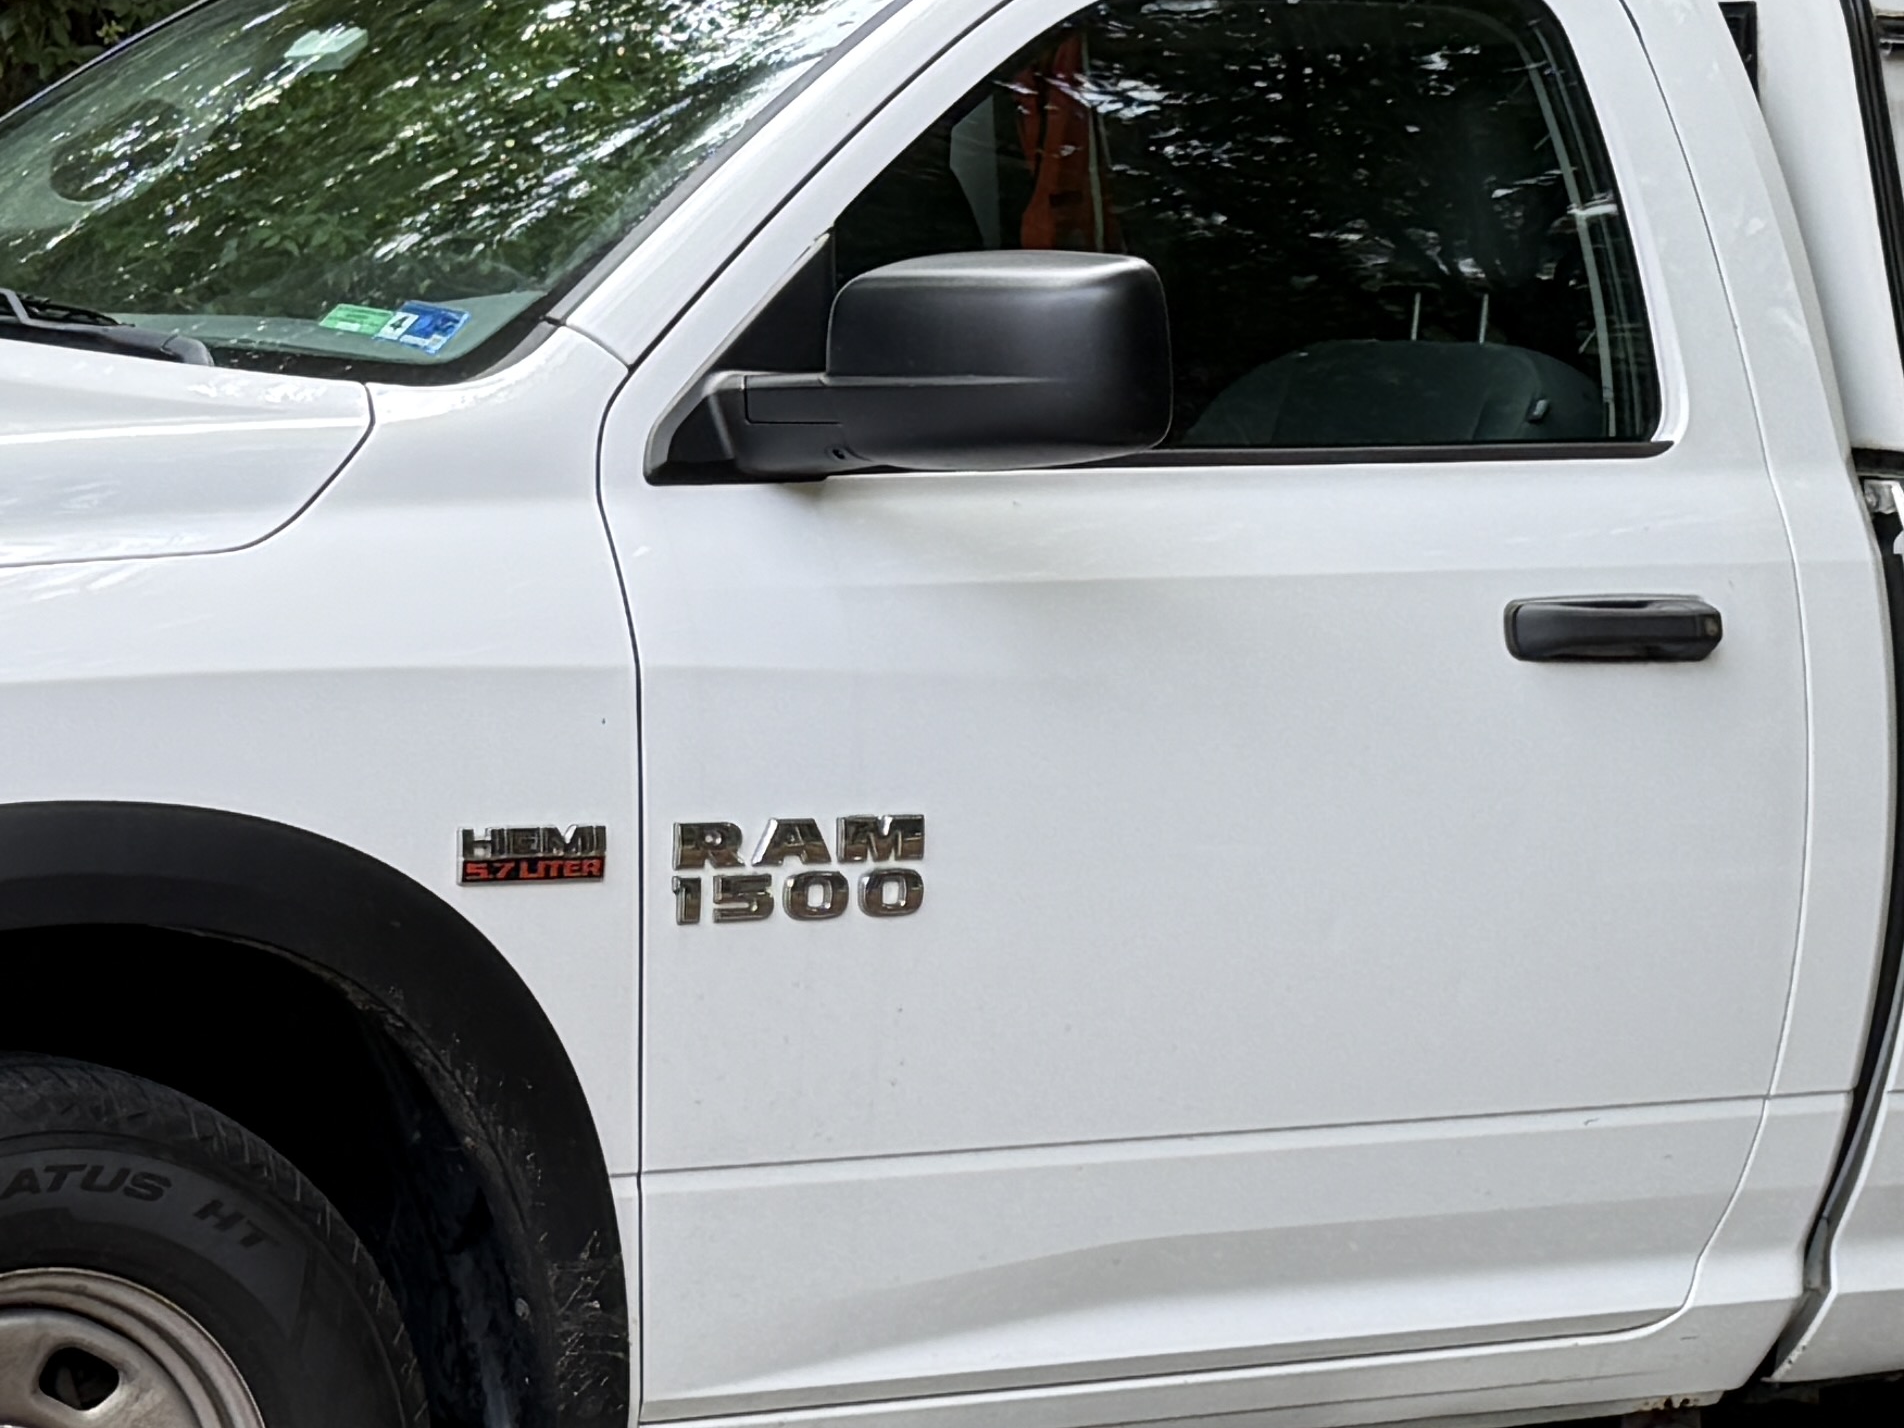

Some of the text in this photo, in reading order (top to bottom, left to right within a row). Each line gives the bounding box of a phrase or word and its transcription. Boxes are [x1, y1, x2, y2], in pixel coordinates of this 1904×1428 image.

[457, 825, 606, 859] HEMI
[672, 815, 925, 869] RAM
[466, 859, 603, 880] 5.7 LITER
[672, 869, 924, 925] 1500
[195, 1200, 278, 1250] HT
